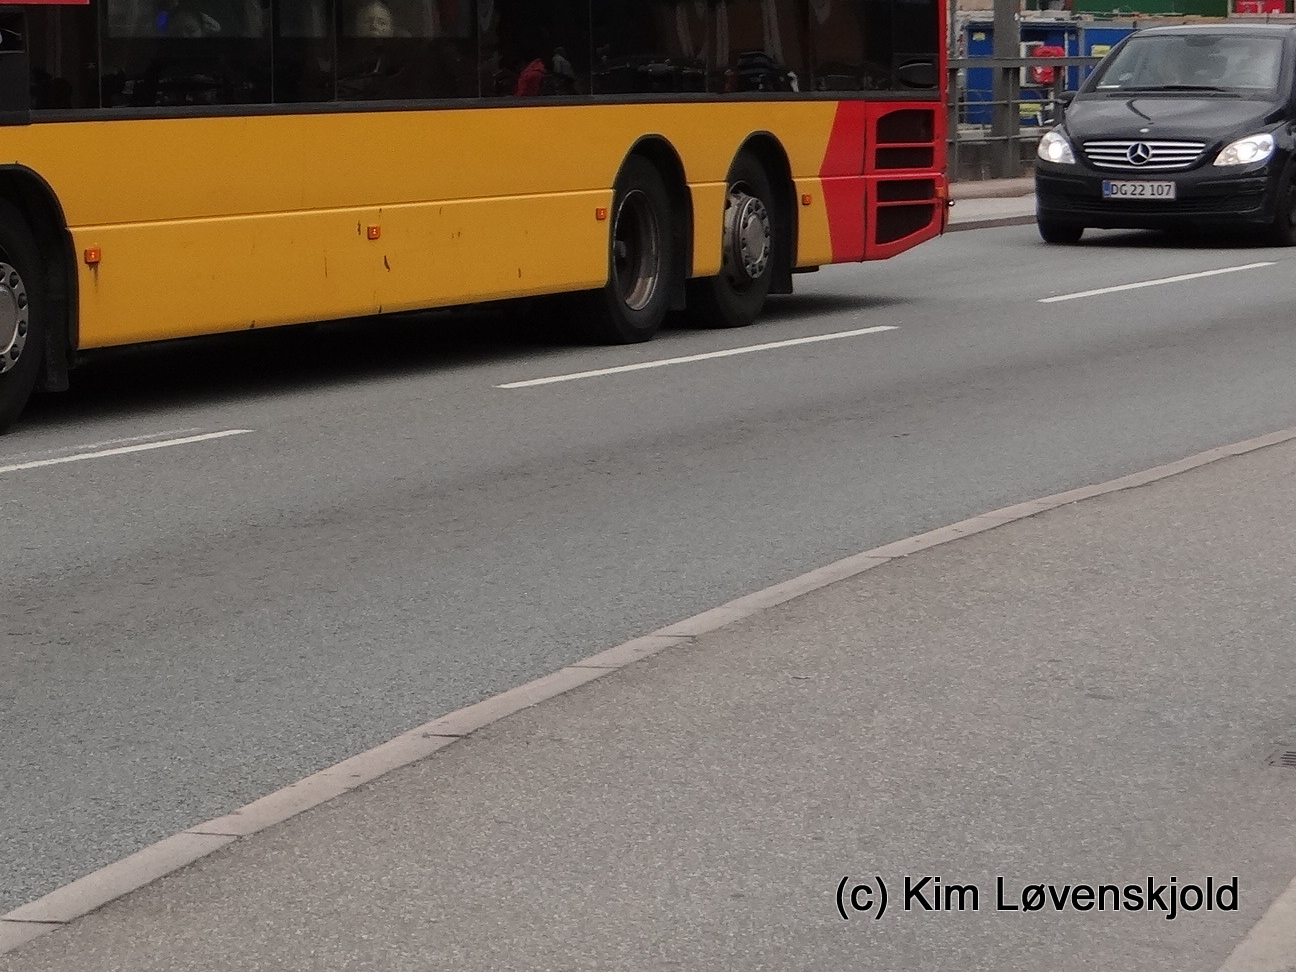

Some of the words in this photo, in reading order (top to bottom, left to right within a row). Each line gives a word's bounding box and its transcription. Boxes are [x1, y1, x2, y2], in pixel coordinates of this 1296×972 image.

[1111, 184, 1128, 196] DG
[1130, 184, 1146, 196] 22
[1149, 184, 1172, 196] 107
